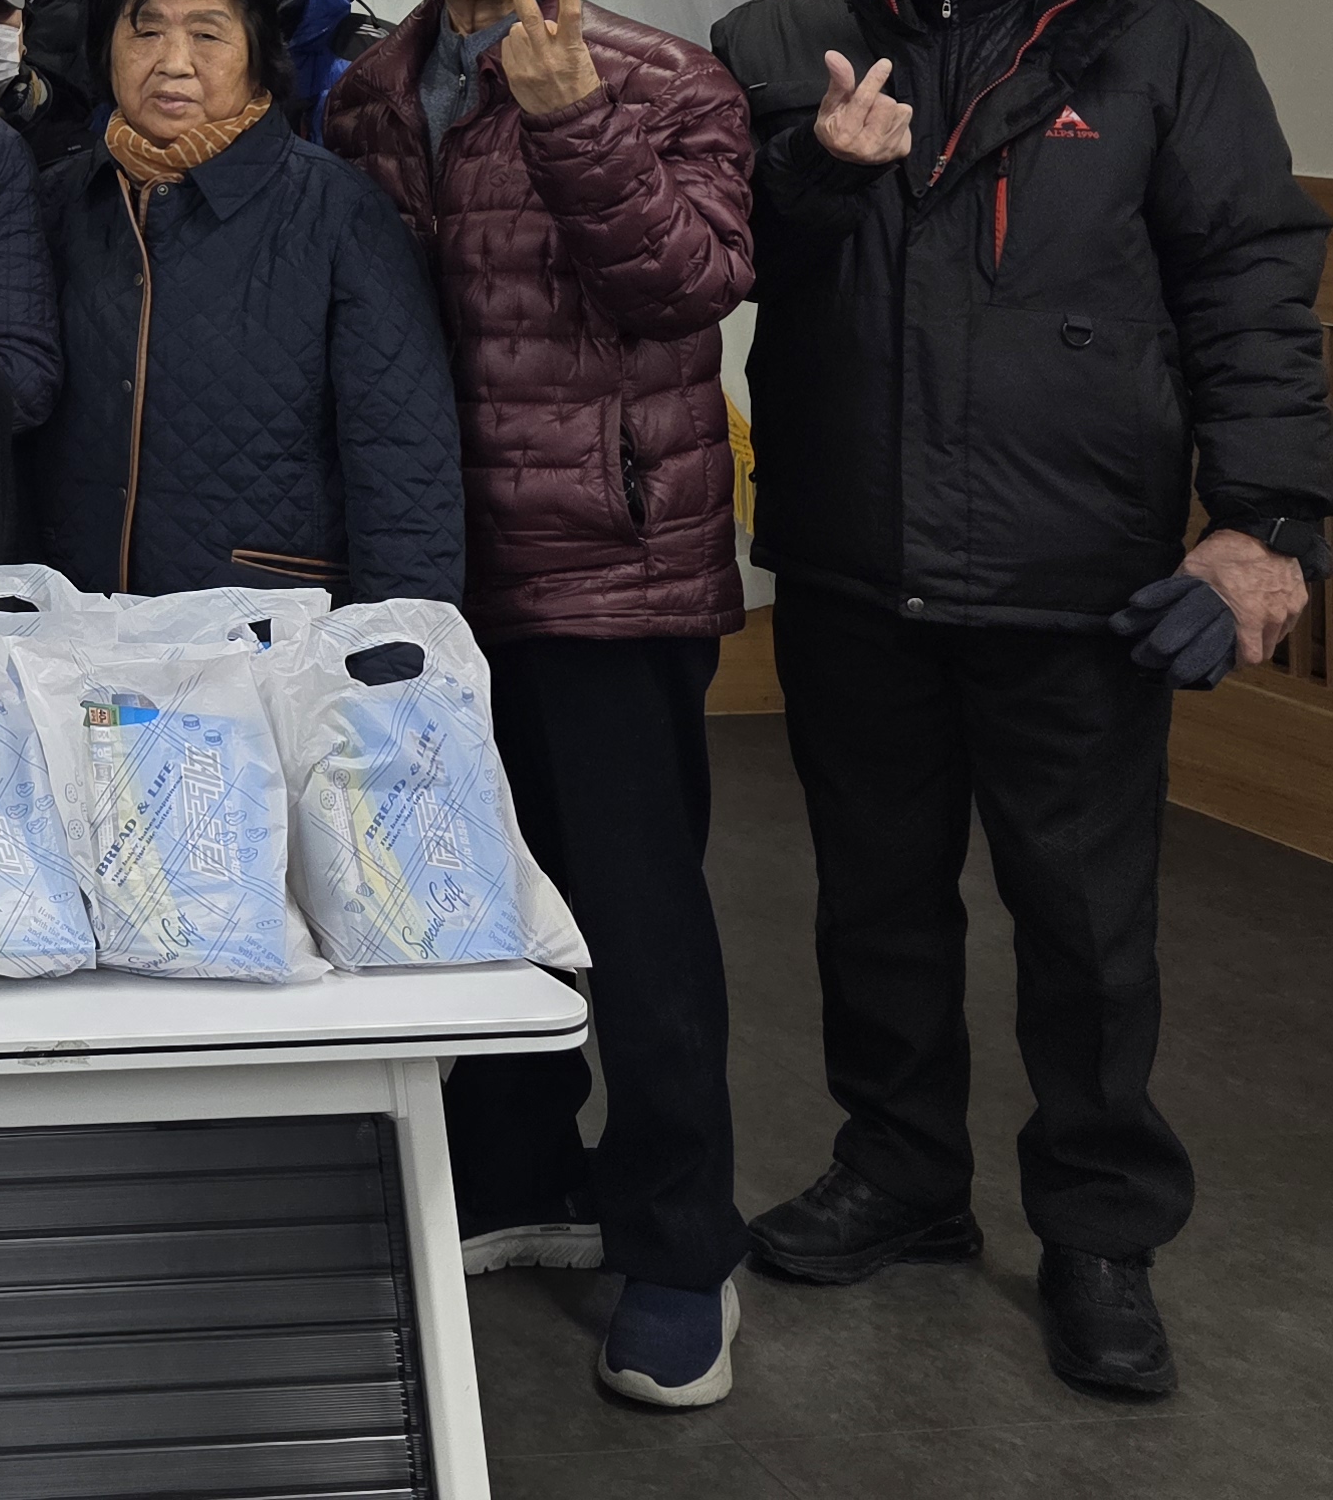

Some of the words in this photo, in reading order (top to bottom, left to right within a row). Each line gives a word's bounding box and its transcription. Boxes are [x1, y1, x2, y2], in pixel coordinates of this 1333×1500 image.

[1045, 130, 1074, 138] ALPS
[1076, 130, 1100, 139] 1996
[365, 779, 406, 839] BREAD
[410, 762, 421, 775] &
[416, 719, 439, 757] LIFE
[380, 830, 391, 845] The
[390, 803, 406, 828] baker
[423, 733, 450, 775] happiness
[95, 818, 137, 876] BREAD
[137, 801, 149, 815] &
[148, 761, 175, 798] LIFE
[111, 867, 122, 881] The
[122, 842, 139, 866] baker
[138, 817, 155, 840] bakes
[154, 773, 183, 815] happiness
[385, 828, 401, 850] Make
[400, 808, 413, 826] your
[117, 866, 132, 886] Make
[132, 845, 147, 865] your
[155, 803, 173, 829] better
[27, 924, 43, 939] and
[40, 933, 54, 946] the
[31, 914, 50, 931] with
[47, 925, 61, 939] the
[58, 933, 80, 952] sweet
[36, 905, 56, 923] Have
[59, 921, 78, 938] great
[76, 931, 93, 947] day
[161, 908, 206, 948] Gift
[402, 901, 445, 959] Special
[429, 872, 470, 913] Gift
[493, 919, 509, 934] and
[506, 929, 520, 942] the
[499, 908, 518, 925] with
[21, 934, 42, 953] Don't
[229, 954, 246, 969] and
[236, 943, 254, 960] with
[251, 954, 267, 969] the
[243, 933, 262, 951] Have
[265, 950, 286, 968] great
